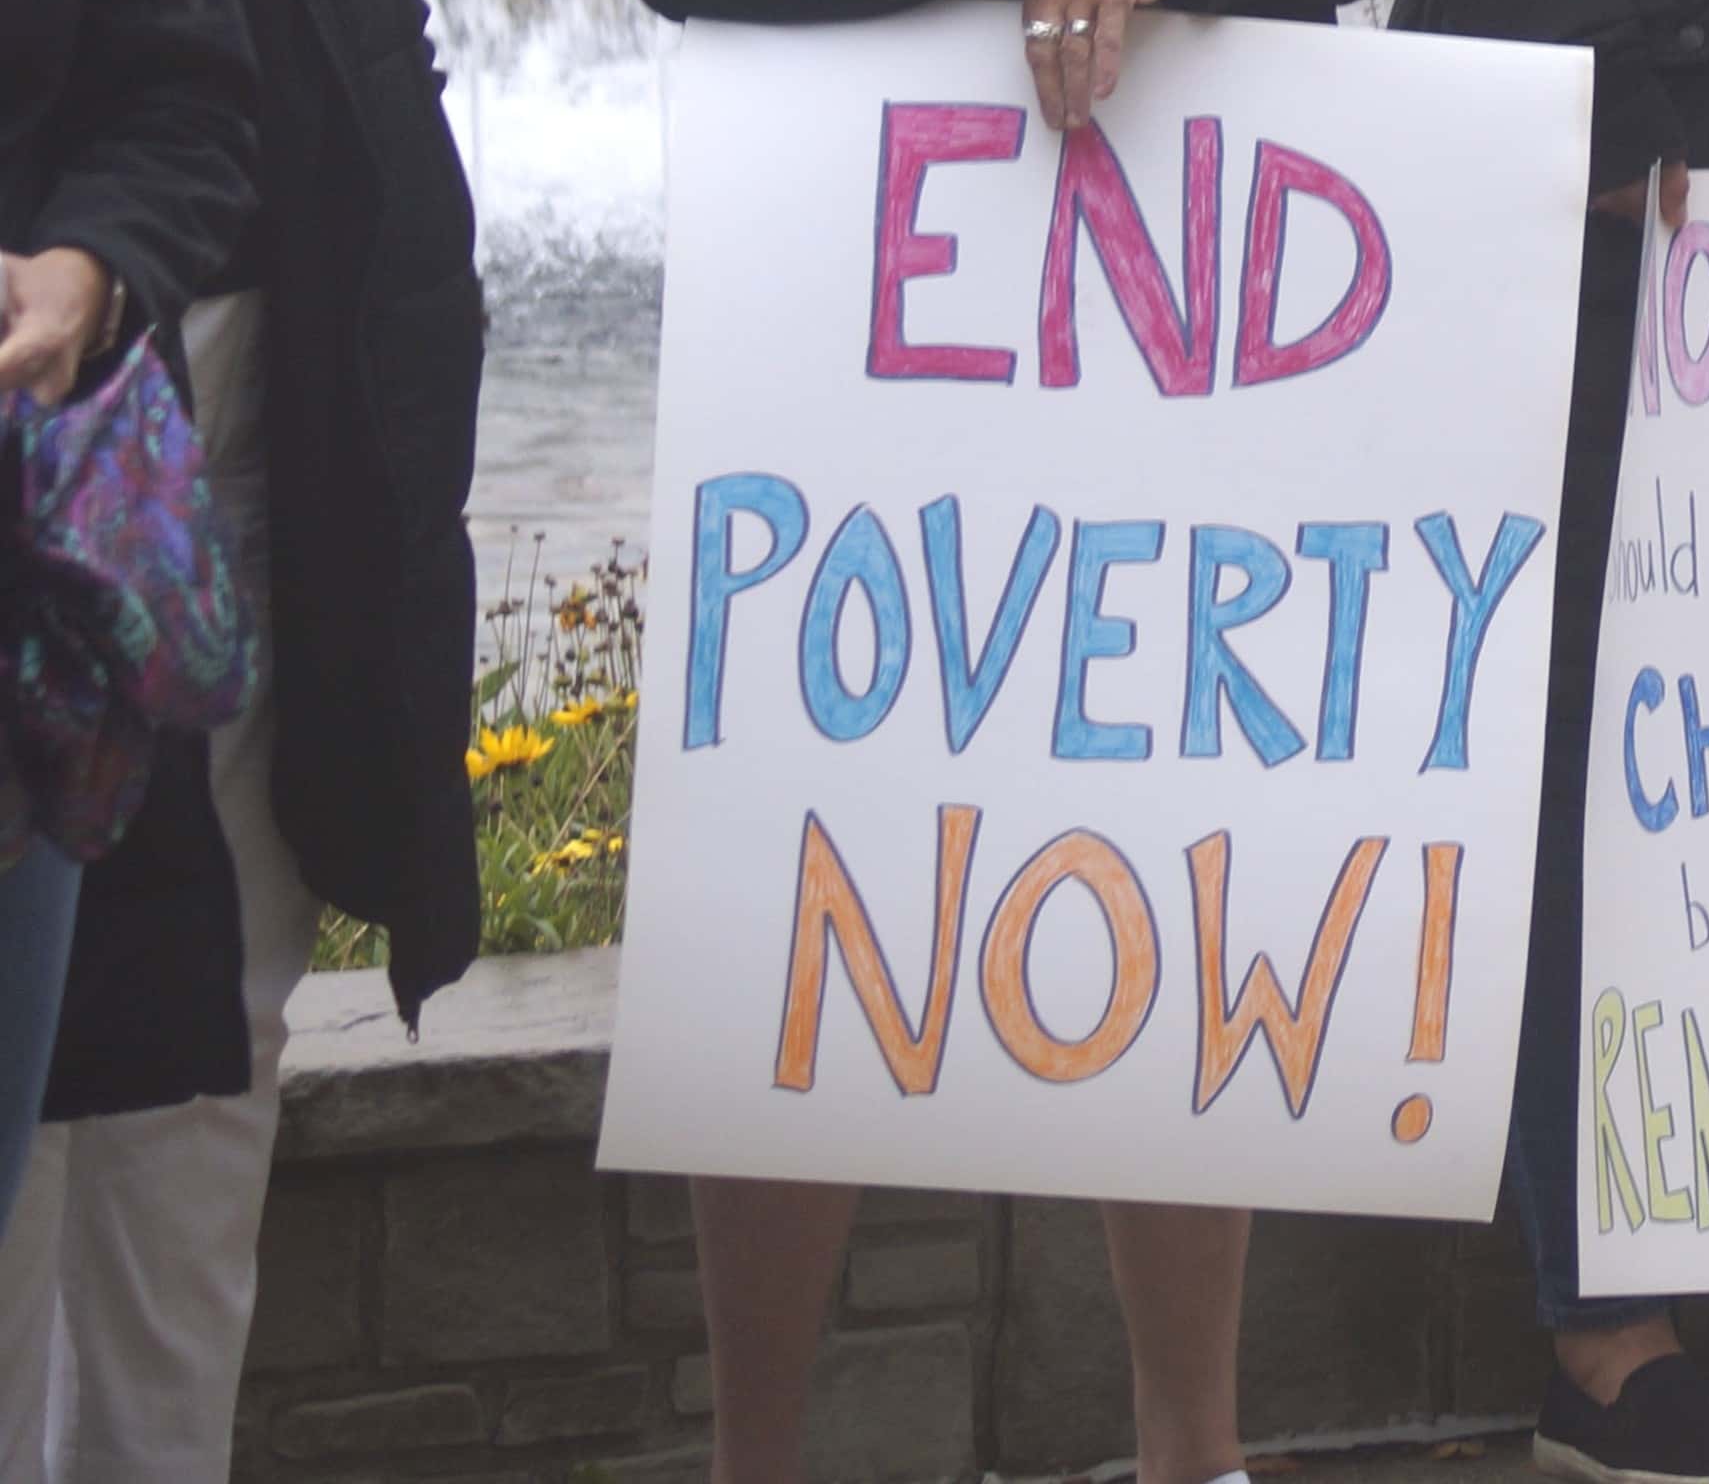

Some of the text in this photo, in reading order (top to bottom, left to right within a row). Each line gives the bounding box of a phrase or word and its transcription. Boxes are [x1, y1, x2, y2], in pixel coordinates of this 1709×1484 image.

[866, 99, 1393, 397] END
[682, 472, 1547, 775] POVERTY
[772, 802, 1465, 1145] NOW!
